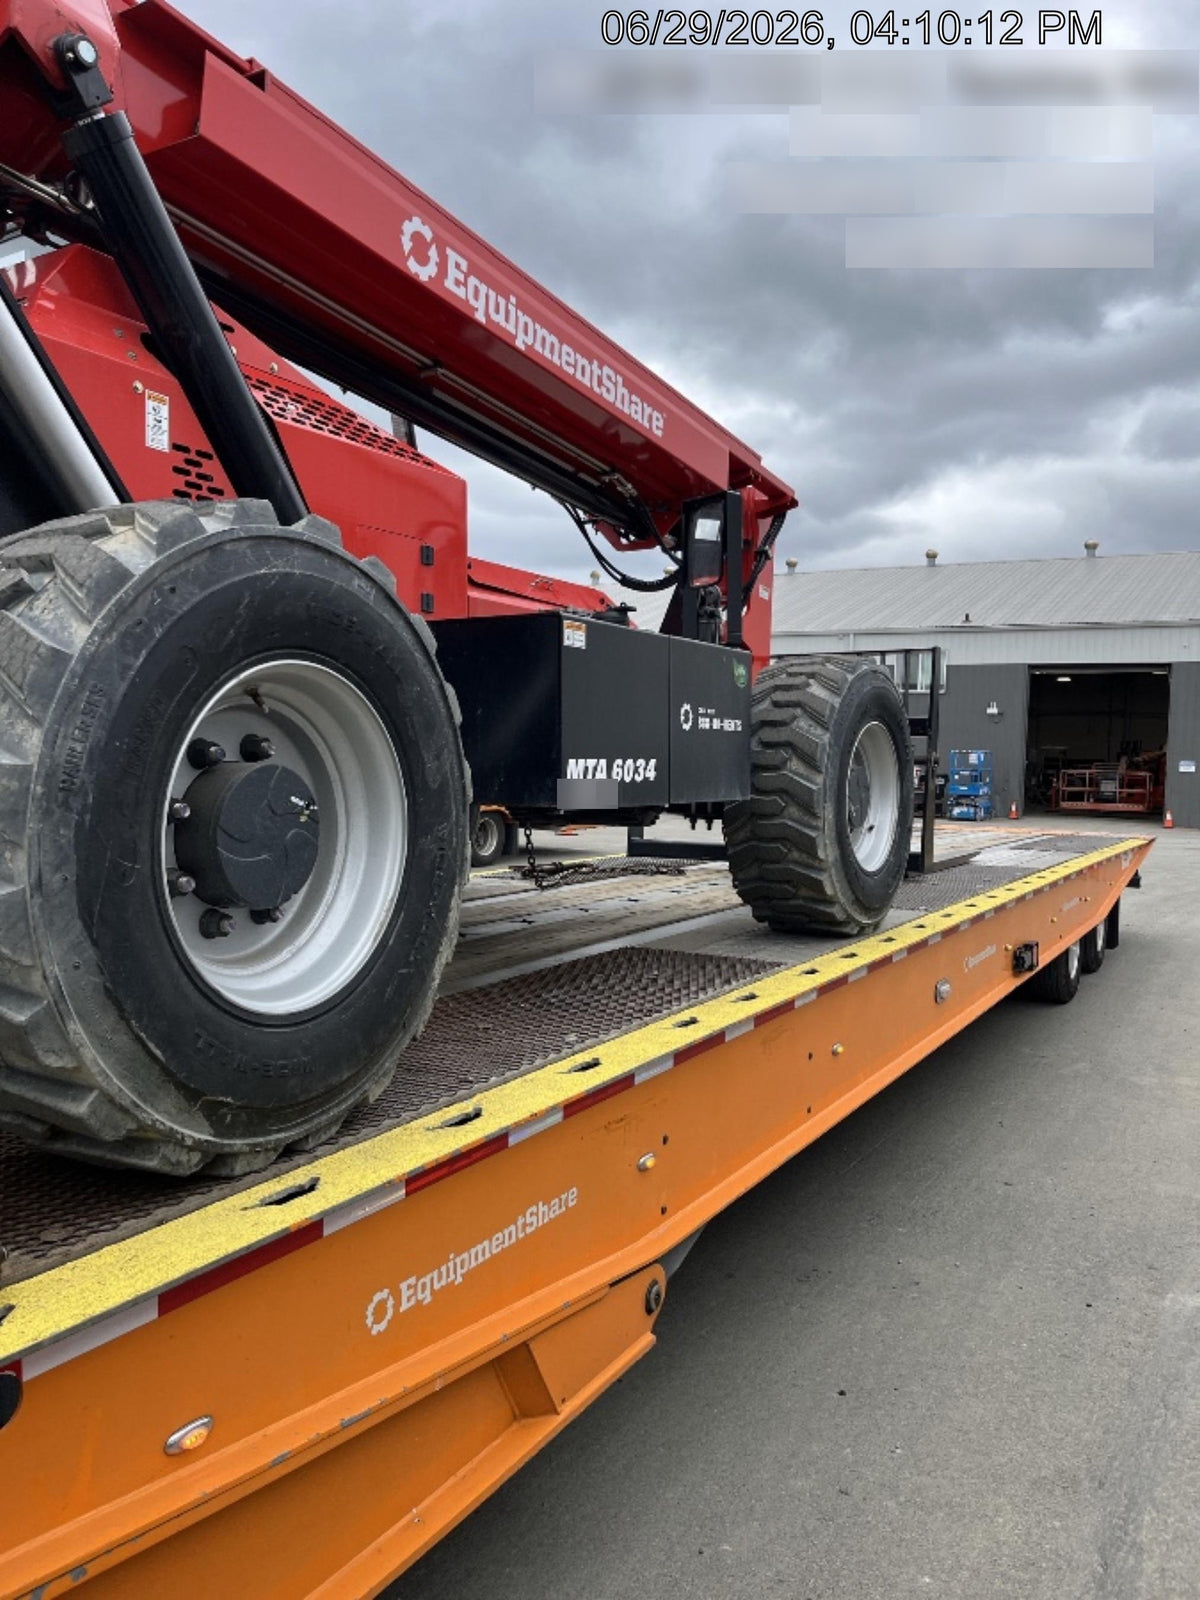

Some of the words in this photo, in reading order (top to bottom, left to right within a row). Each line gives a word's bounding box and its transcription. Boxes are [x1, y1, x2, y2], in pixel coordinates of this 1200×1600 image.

[443, 246, 665, 438] EquipmentShare
[566, 758, 608, 779] MTA
[611, 758, 657, 783] 6034
[399, 1186, 578, 1312] EquipmentShare
